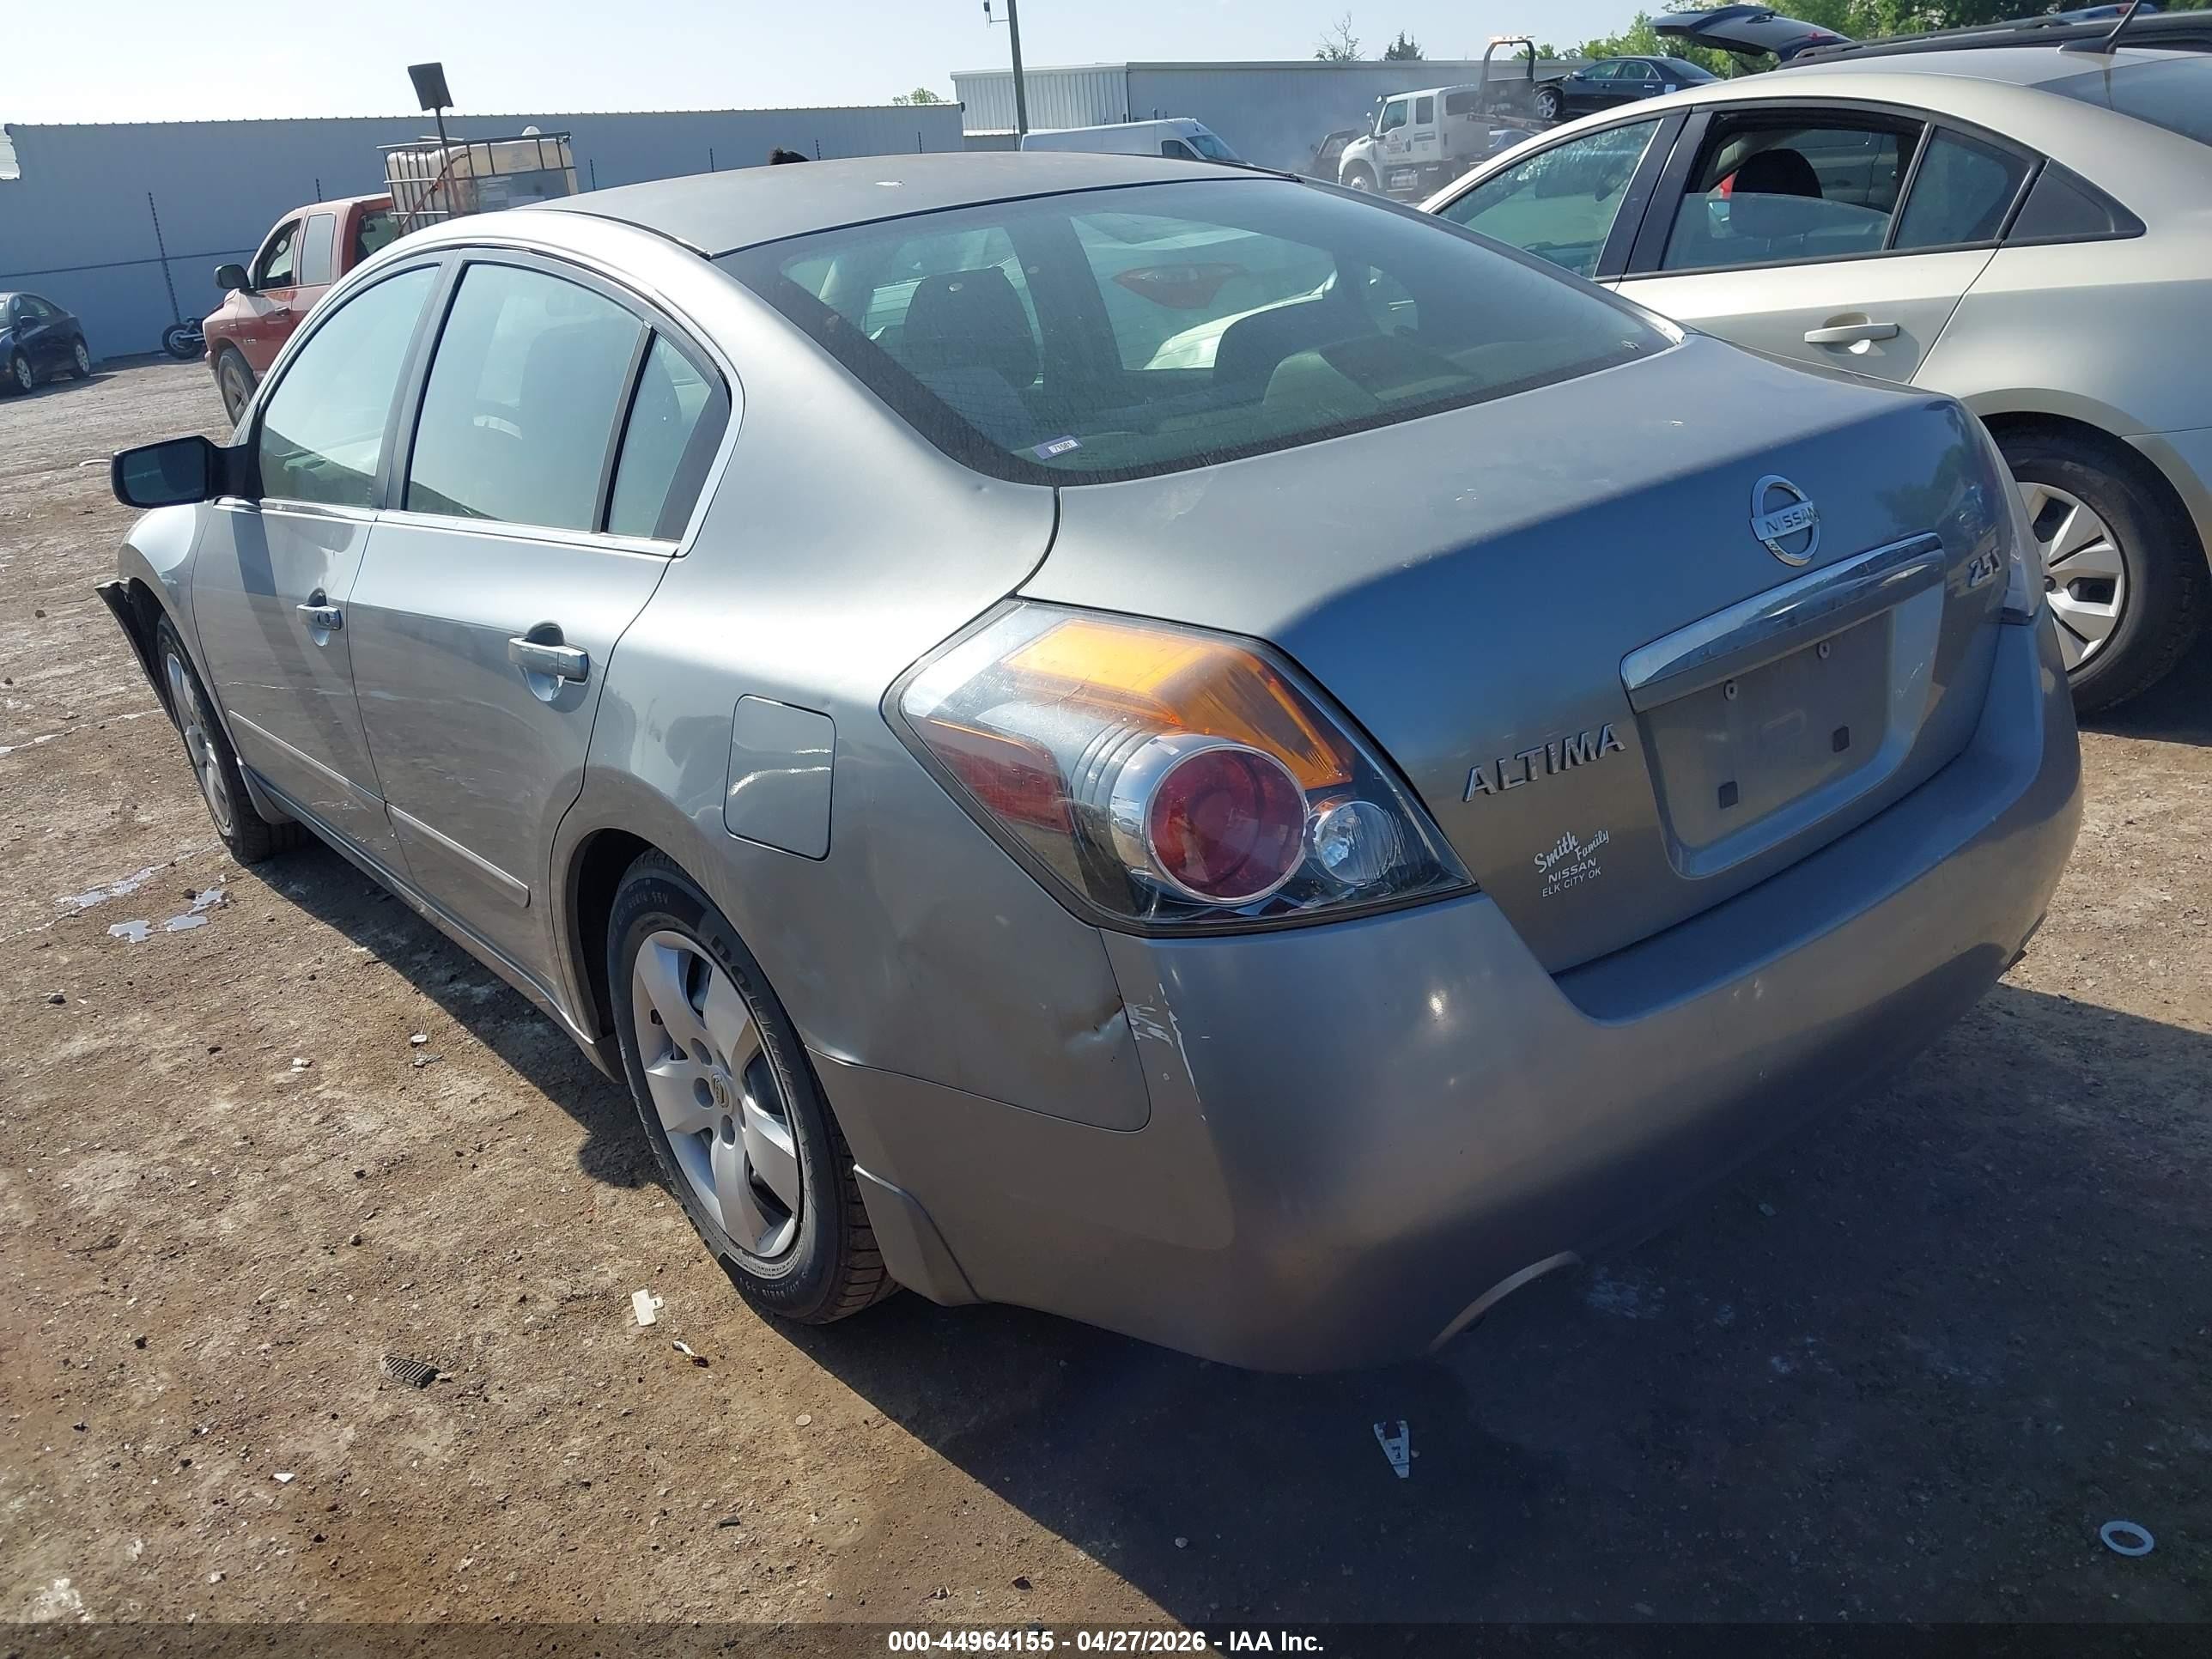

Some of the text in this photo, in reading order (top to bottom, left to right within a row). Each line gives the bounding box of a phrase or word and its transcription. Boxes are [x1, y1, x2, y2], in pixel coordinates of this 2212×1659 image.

[1765, 505, 1816, 534] NISSAN
[1462, 722, 1626, 803] ALTIMA
[1534, 829, 1610, 874] Smith Family
[1541, 866, 1602, 898] ELK CITY OK
[1547, 857, 1597, 884] NISSAN
